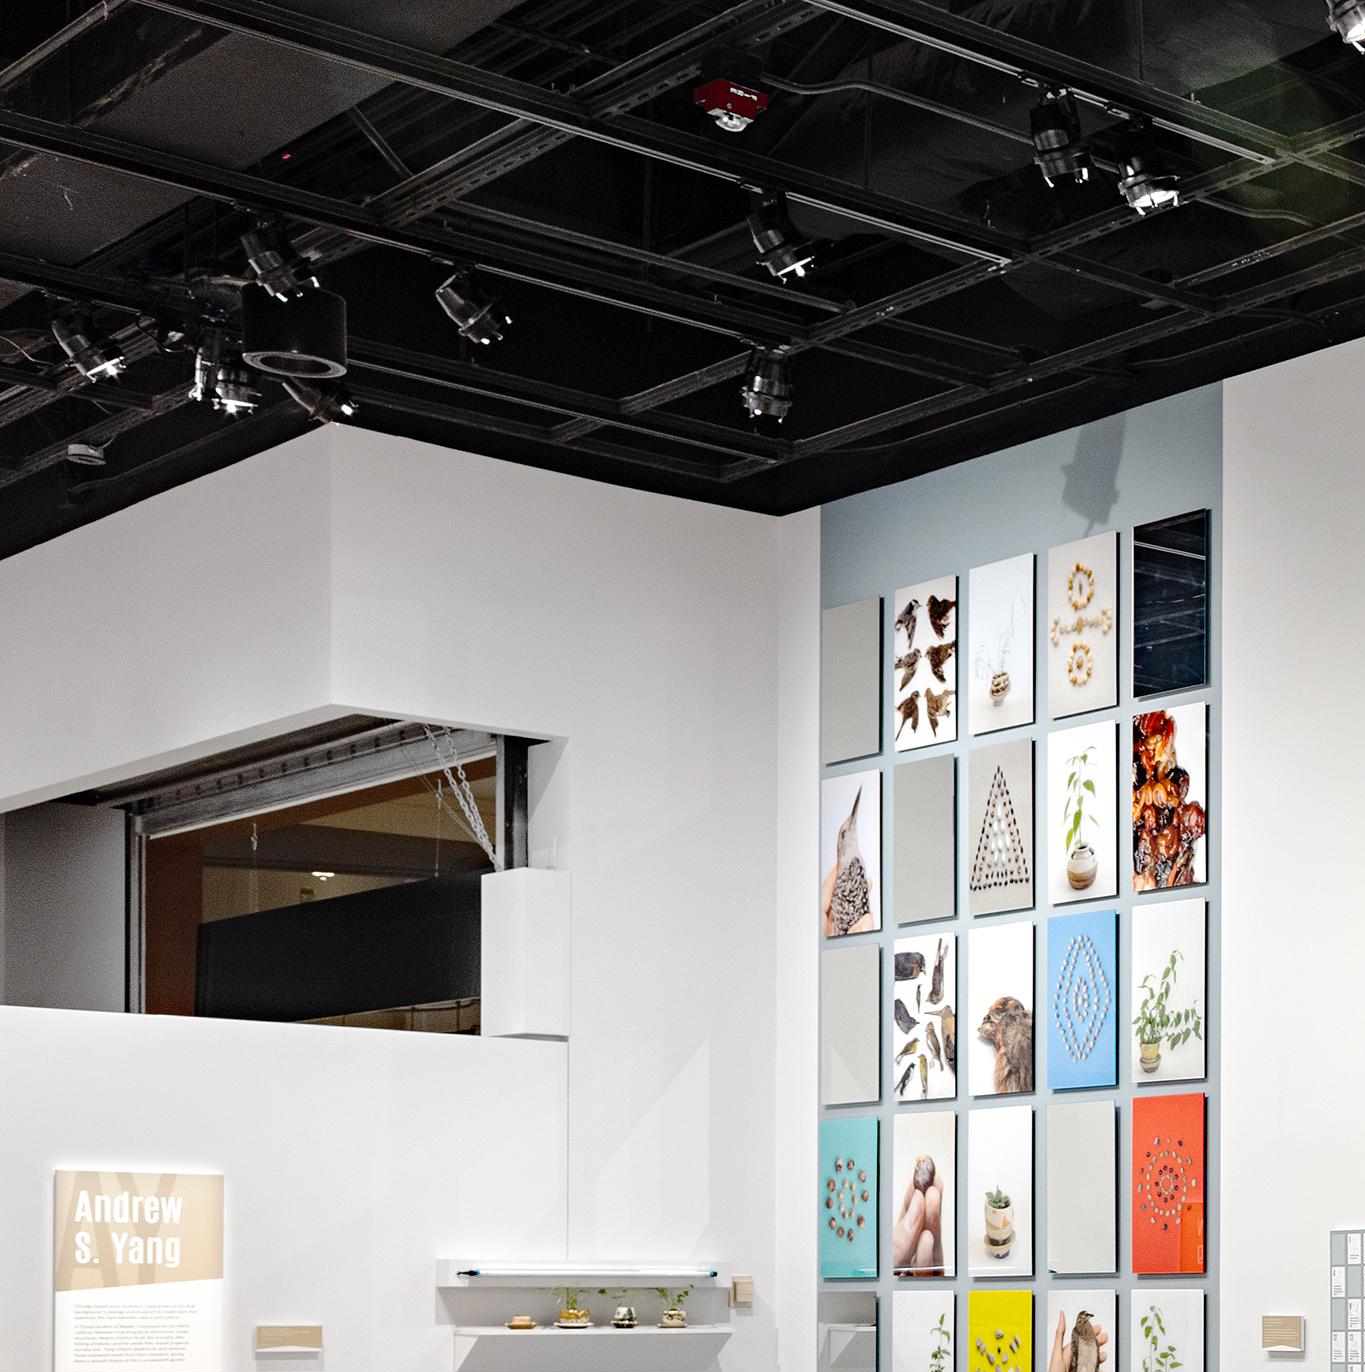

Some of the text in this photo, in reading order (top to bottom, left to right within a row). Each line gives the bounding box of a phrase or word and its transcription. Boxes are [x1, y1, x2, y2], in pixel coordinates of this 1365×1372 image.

[74, 1190, 183, 1224] Andrew
[74, 1231, 181, 1268] S. Yang
